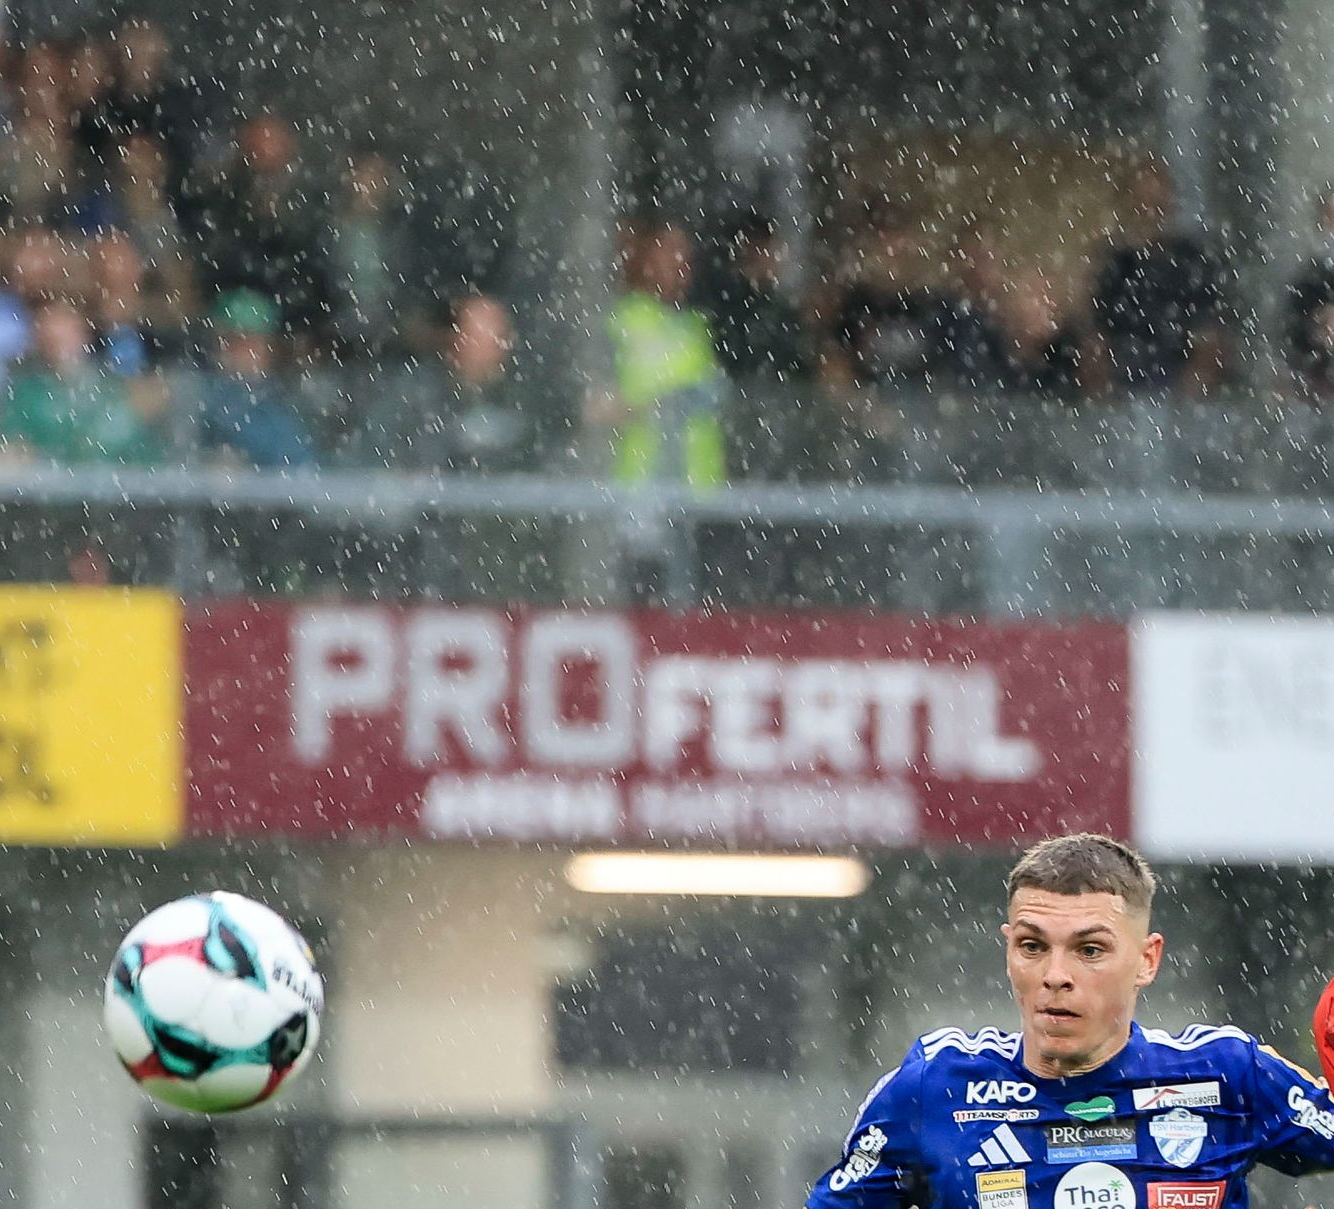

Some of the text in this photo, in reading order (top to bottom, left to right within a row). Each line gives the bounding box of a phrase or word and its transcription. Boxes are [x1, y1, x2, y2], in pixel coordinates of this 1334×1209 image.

[966, 1080, 1037, 1104] KAPO
[982, 1190, 1023, 1202] BUNDES
[1162, 1193, 1216, 1206] FAUST
[991, 1200, 1015, 1209] LIGA
